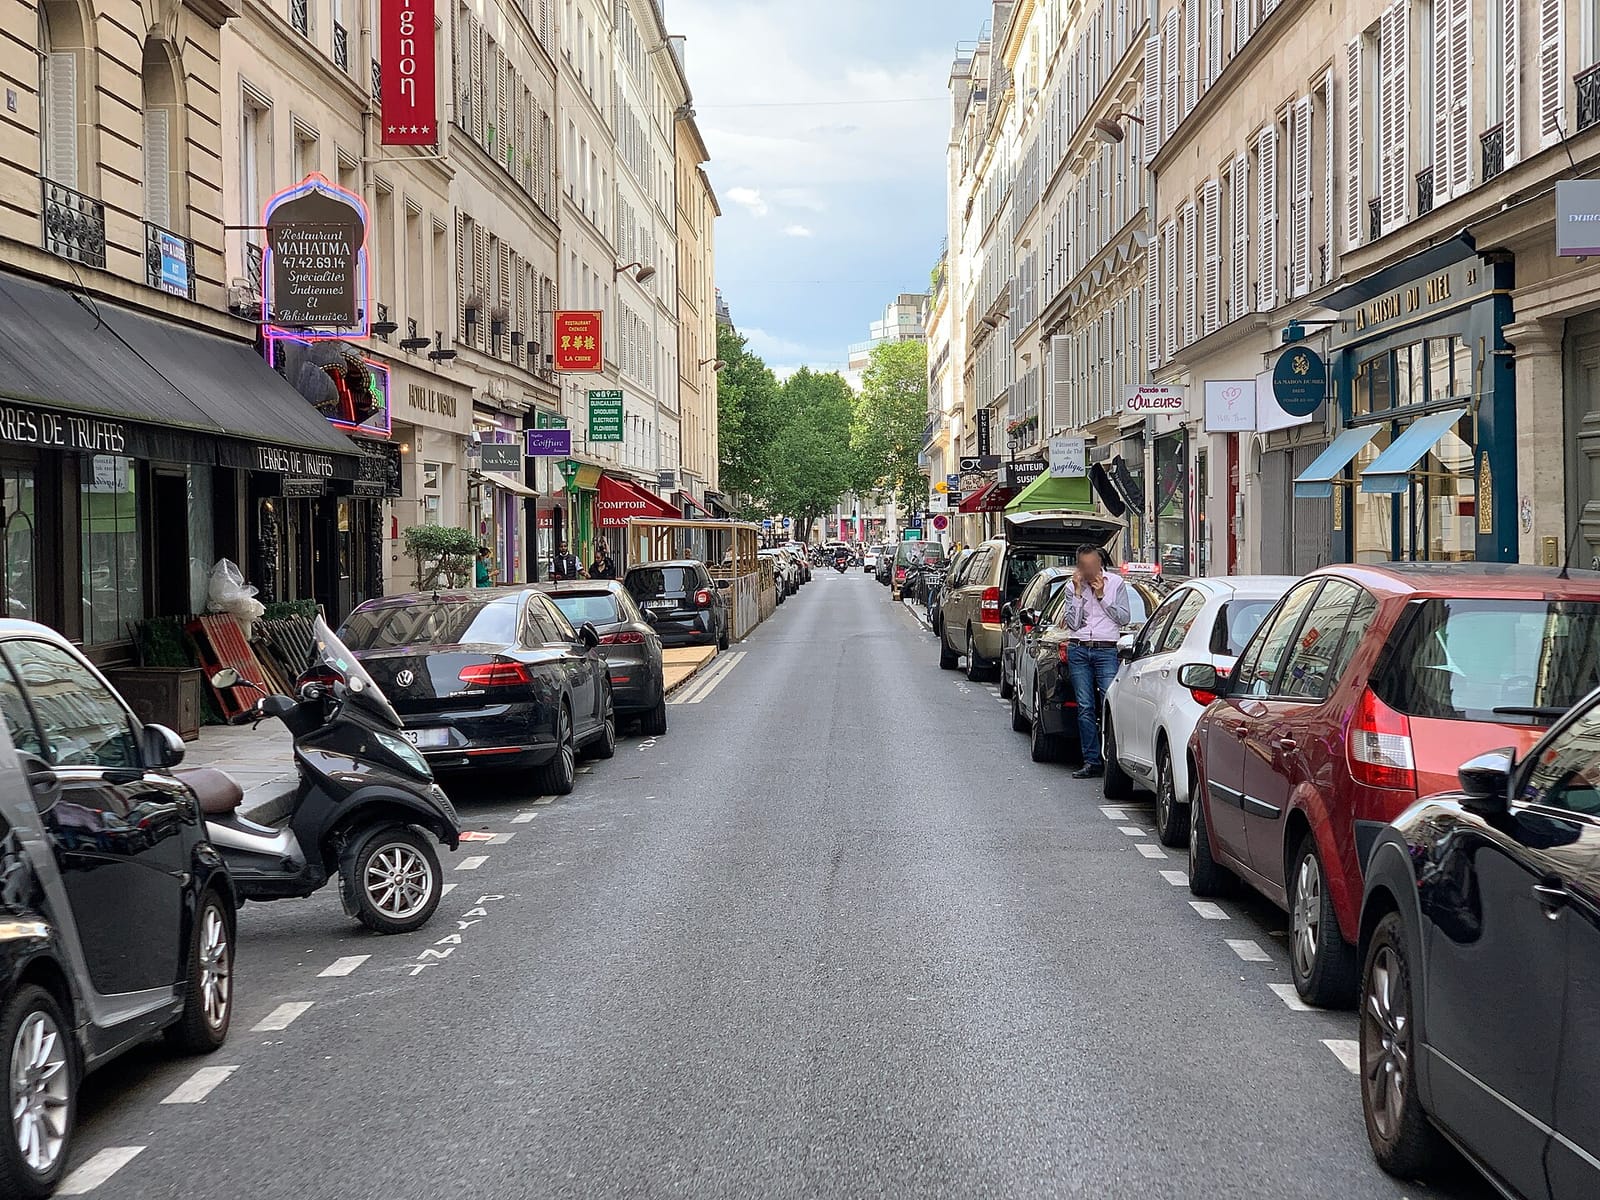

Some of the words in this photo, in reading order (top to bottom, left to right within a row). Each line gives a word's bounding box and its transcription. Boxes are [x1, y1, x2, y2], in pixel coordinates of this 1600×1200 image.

[279, 229, 342, 240] Restaurant
[277, 242, 350, 255] MAHATMA
[282, 257, 346, 269] 47.42.69.14
[290, 284, 343, 295] Indiennes
[1355, 307, 1365, 331] LA
[1369, 293, 1400, 326] MAISON
[1406, 286, 1419, 313] DU
[1426, 273, 1451, 305] MIEL
[278, 310, 348, 321] Pakistanaises
[41, 414, 64, 445] DE
[68, 417, 125, 452] TRUFFES
[533, 438, 564, 450] Coiffure
[1050, 460, 1084, 474] Angélique
[598, 501, 646, 509] COMPTOIR
[408, 894, 506, 977] PAYANT
